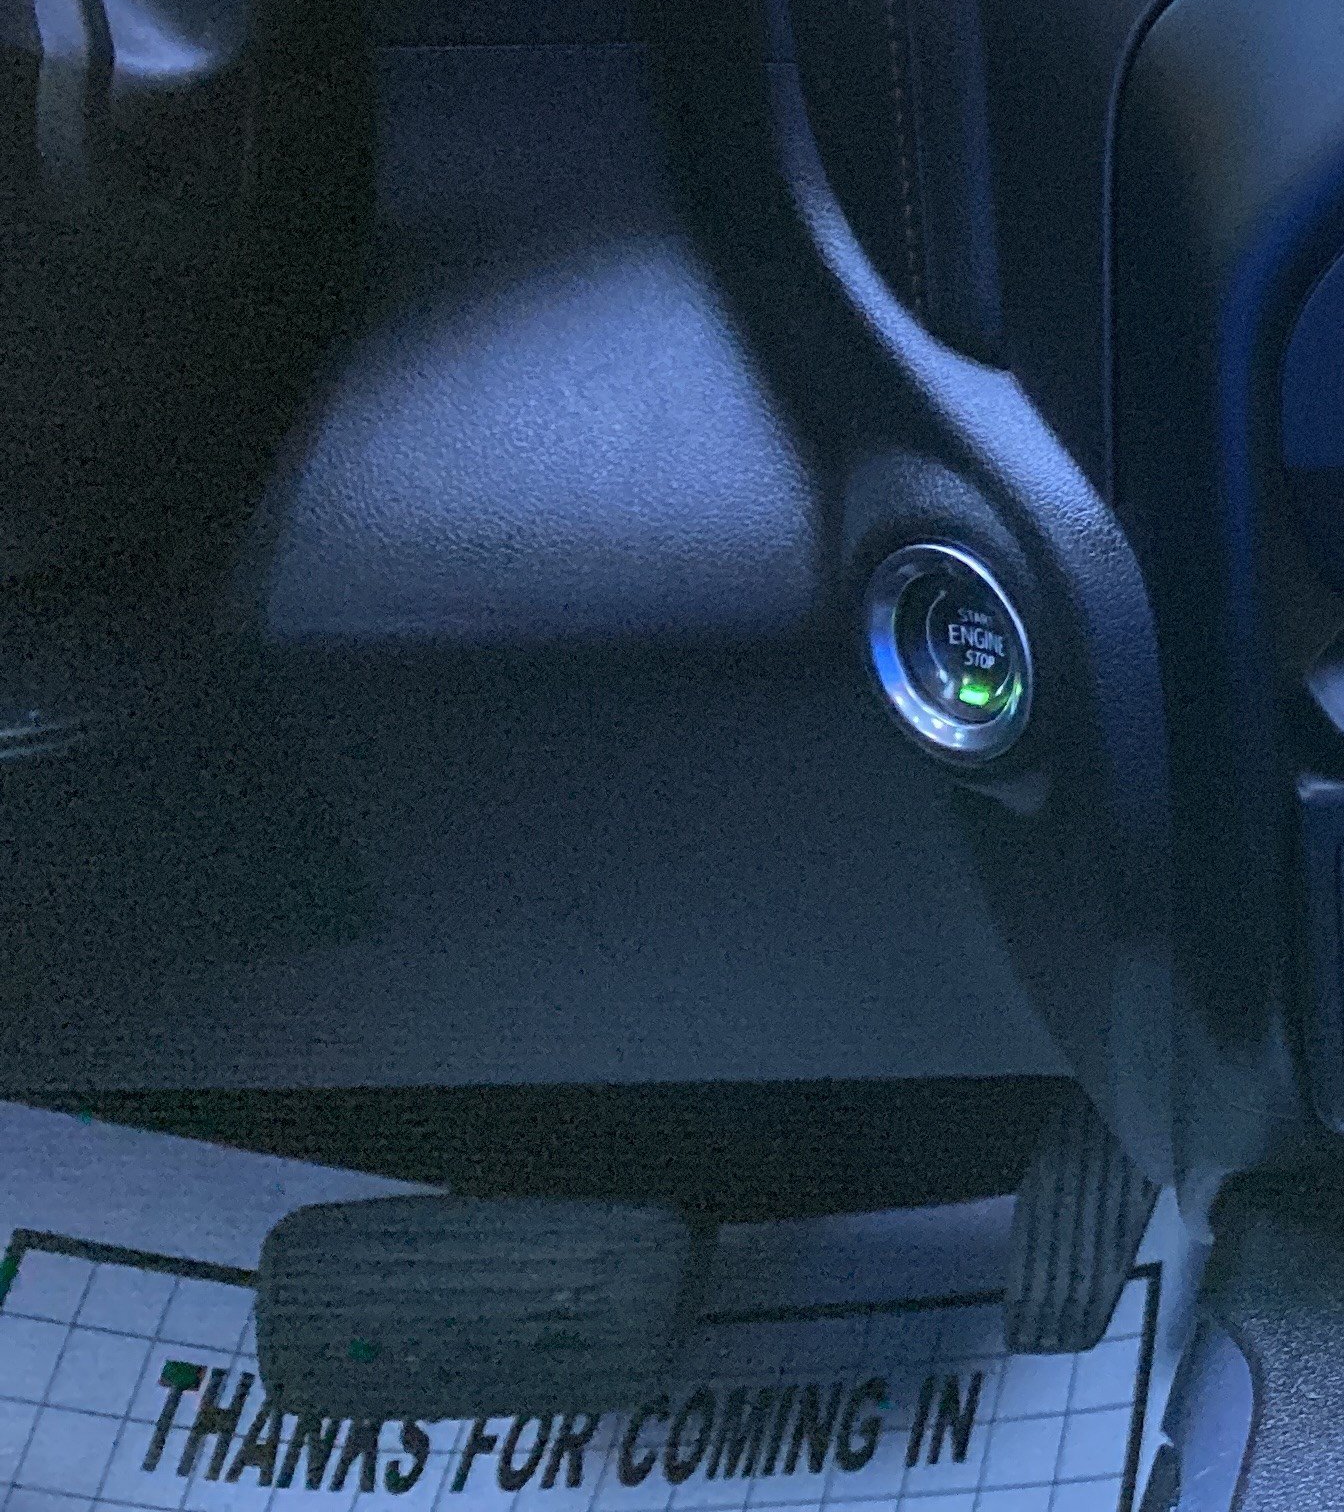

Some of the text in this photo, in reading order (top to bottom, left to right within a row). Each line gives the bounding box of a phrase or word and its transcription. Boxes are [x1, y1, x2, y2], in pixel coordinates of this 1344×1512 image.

[964, 649, 995, 669] STOP
[140, 1360, 985, 1495] THANKS FOR COMING IN
